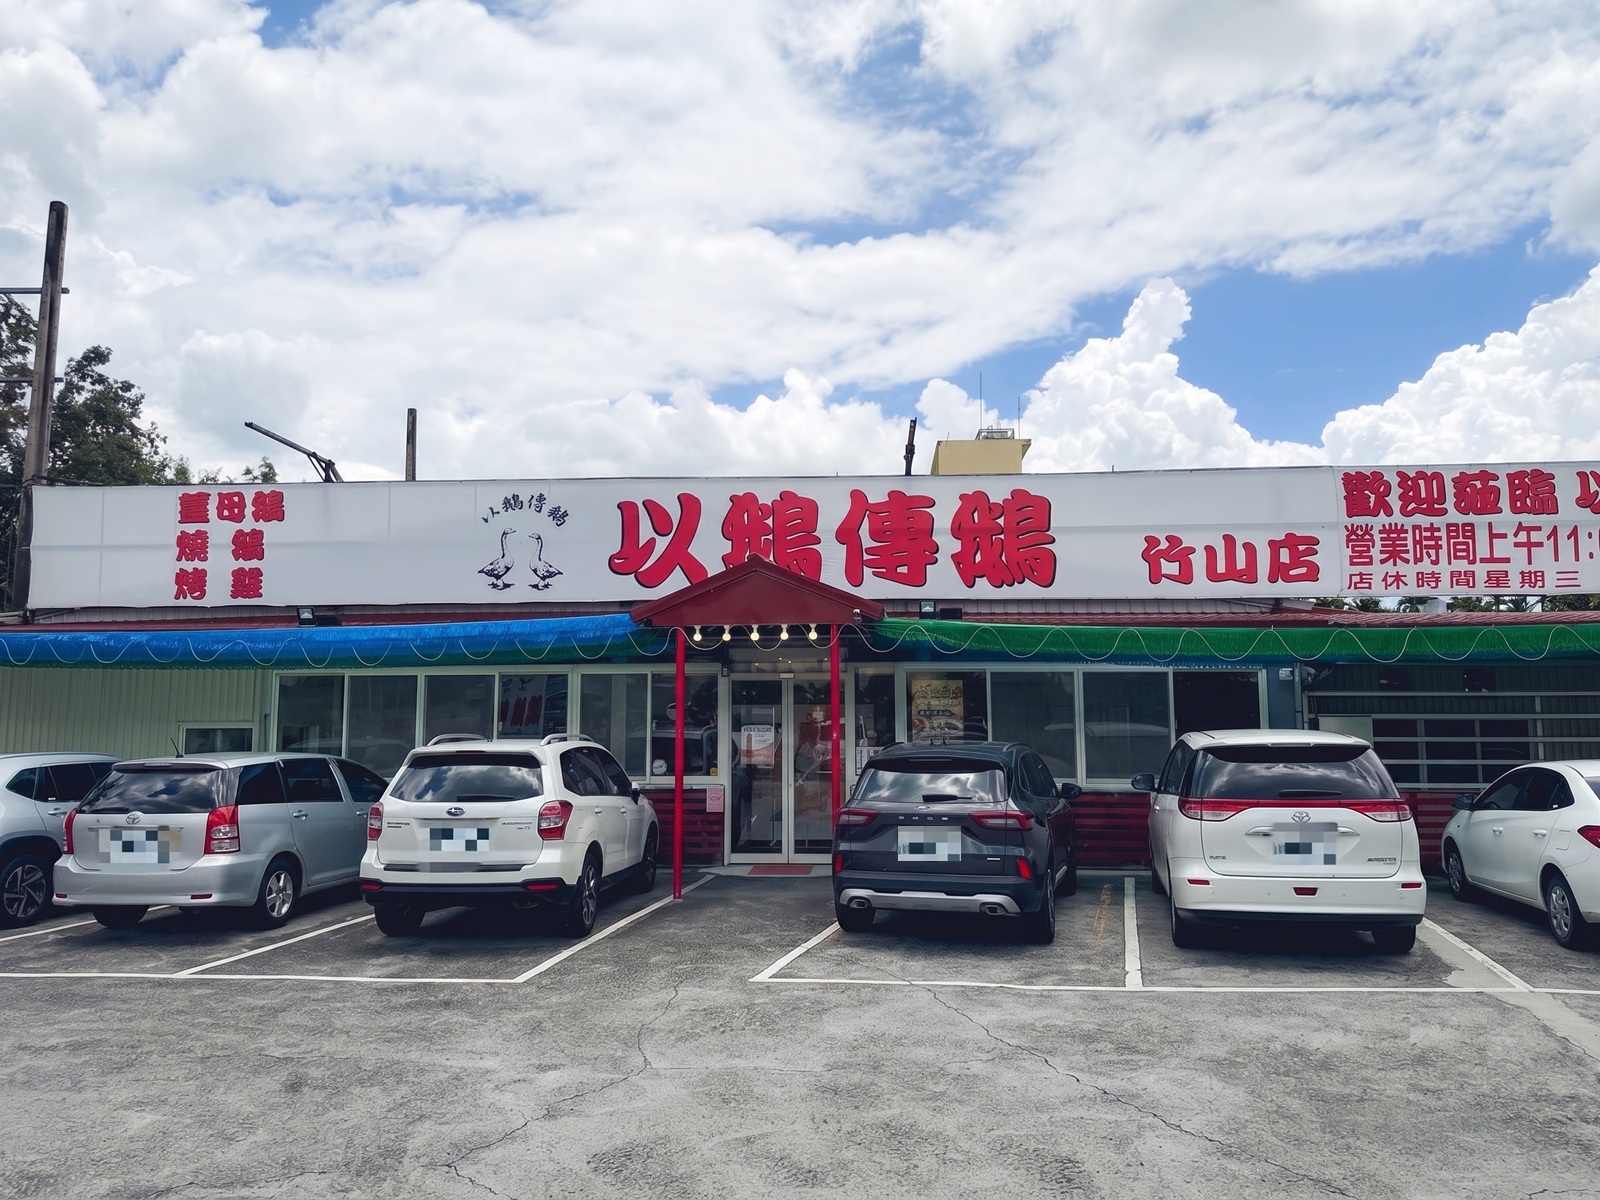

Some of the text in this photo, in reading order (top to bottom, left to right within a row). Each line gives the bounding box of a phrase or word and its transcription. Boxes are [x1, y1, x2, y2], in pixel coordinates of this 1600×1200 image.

[482, 493, 569, 527] 以鵝傳鵝
[608, 489, 1057, 588] 以鵝傳鵝
[1141, 532, 1320, 584] 竹山店
[1344, 521, 1600, 567] 營業時間上午11:
[1347, 570, 1581, 590] 店休時間星期三
